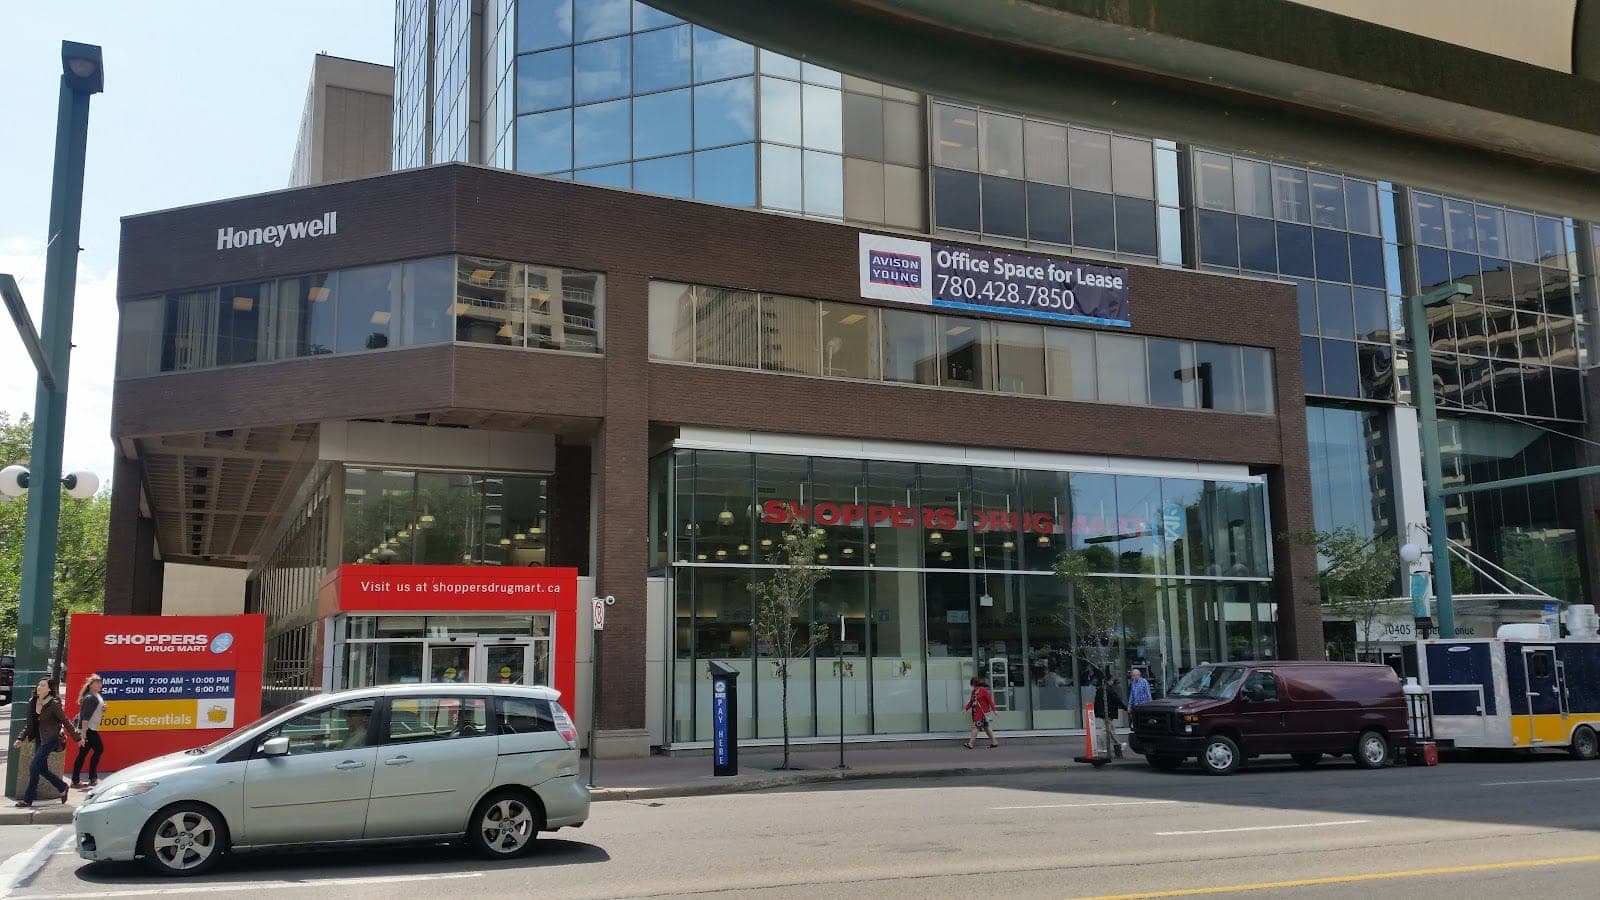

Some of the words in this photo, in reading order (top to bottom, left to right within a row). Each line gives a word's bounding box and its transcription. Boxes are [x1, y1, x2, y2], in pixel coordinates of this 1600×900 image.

[217, 211, 337, 250] Honeywell
[872, 255, 919, 270] AVISON
[937, 250, 989, 273] Office
[994, 257, 1045, 281] Space
[1048, 262, 1073, 284] for
[1077, 268, 1123, 290] Lease
[873, 268, 919, 283] YOUNG
[937, 274, 1075, 310] 780.428.7850
[762, 500, 958, 530] SHOPPERS
[972, 509, 1054, 535] DRUG
[361, 581, 390, 592] Visit
[397, 583, 410, 592] us
[416, 583, 428, 592] at
[433, 582, 560, 594] shoppersdrugmart.ca
[1455, 627, 1474, 635] enue
[104, 634, 208, 645] SHOPPERS
[128, 713, 192, 726] Essentials
